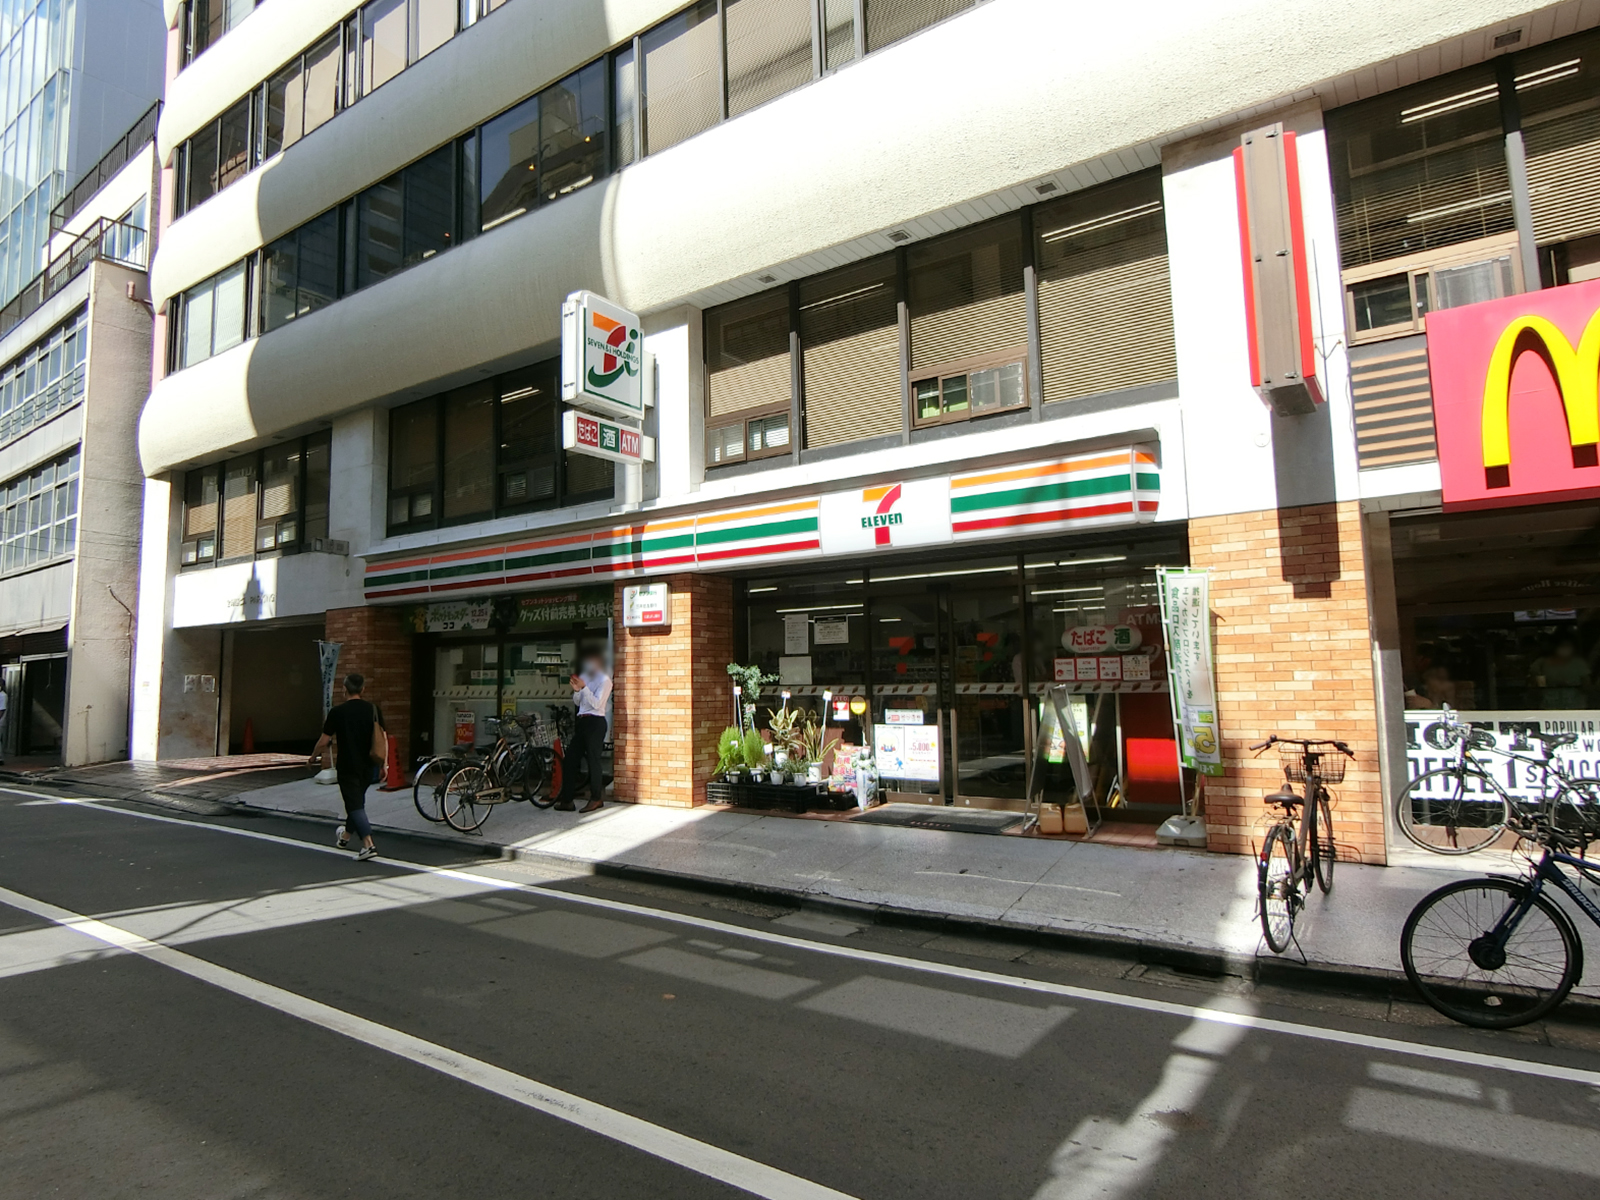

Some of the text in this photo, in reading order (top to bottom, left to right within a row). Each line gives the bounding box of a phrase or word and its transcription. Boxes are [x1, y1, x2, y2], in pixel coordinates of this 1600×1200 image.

[612, 347, 639, 364] HOLDINGS
[577, 421, 639, 454] たばこ 酒 ATM
[861, 512, 903, 529] ELEVEN
[443, 622, 455, 630] ココ
[1071, 628, 1130, 646] たばこ 酒
[1562, 879, 1600, 922] BRIDGES
